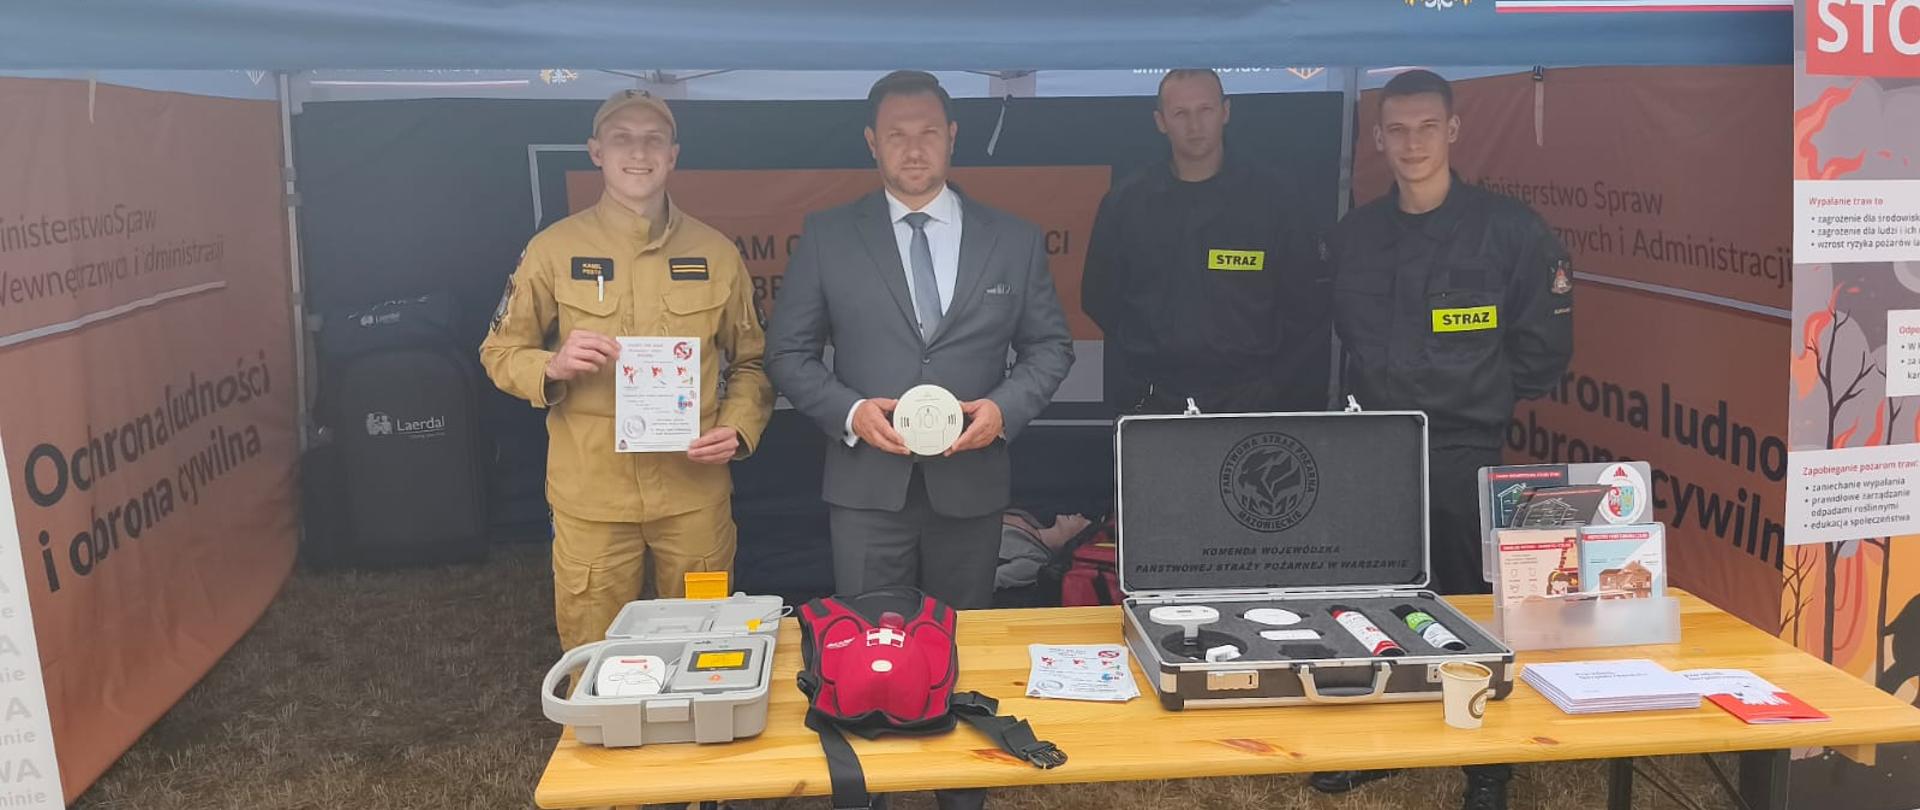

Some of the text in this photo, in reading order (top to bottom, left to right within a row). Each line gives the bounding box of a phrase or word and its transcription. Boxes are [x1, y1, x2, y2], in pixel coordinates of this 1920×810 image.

[1817, 0, 1920, 55] STO
[1470, 176, 1663, 217] inisterstwo Spraw
[1809, 196, 1884, 208] Wypalanie traw to
[1863, 213, 1876, 223] dla
[0, 213, 113, 252] inisterstwo
[1863, 227, 1876, 235] dla
[1877, 226, 1898, 235] ludzi
[1904, 226, 1917, 235] ich
[735, 234, 775, 261] AM
[1045, 231, 1069, 255] CI
[1618, 227, 1625, 256] i
[1817, 240, 1845, 249] wzrost
[397, 416, 445, 431] Laerdal
[1550, 371, 1788, 482] rona ludno
[1803, 464, 1858, 477] Zapobieganie
[1812, 477, 1905, 492] zaniechanie wypalania
[38, 423, 262, 592] i obrona cywilna
[1811, 507, 1852, 518] odpadami
[1651, 468, 1785, 572] cywiln
[1811, 518, 1848, 530] edukacja
